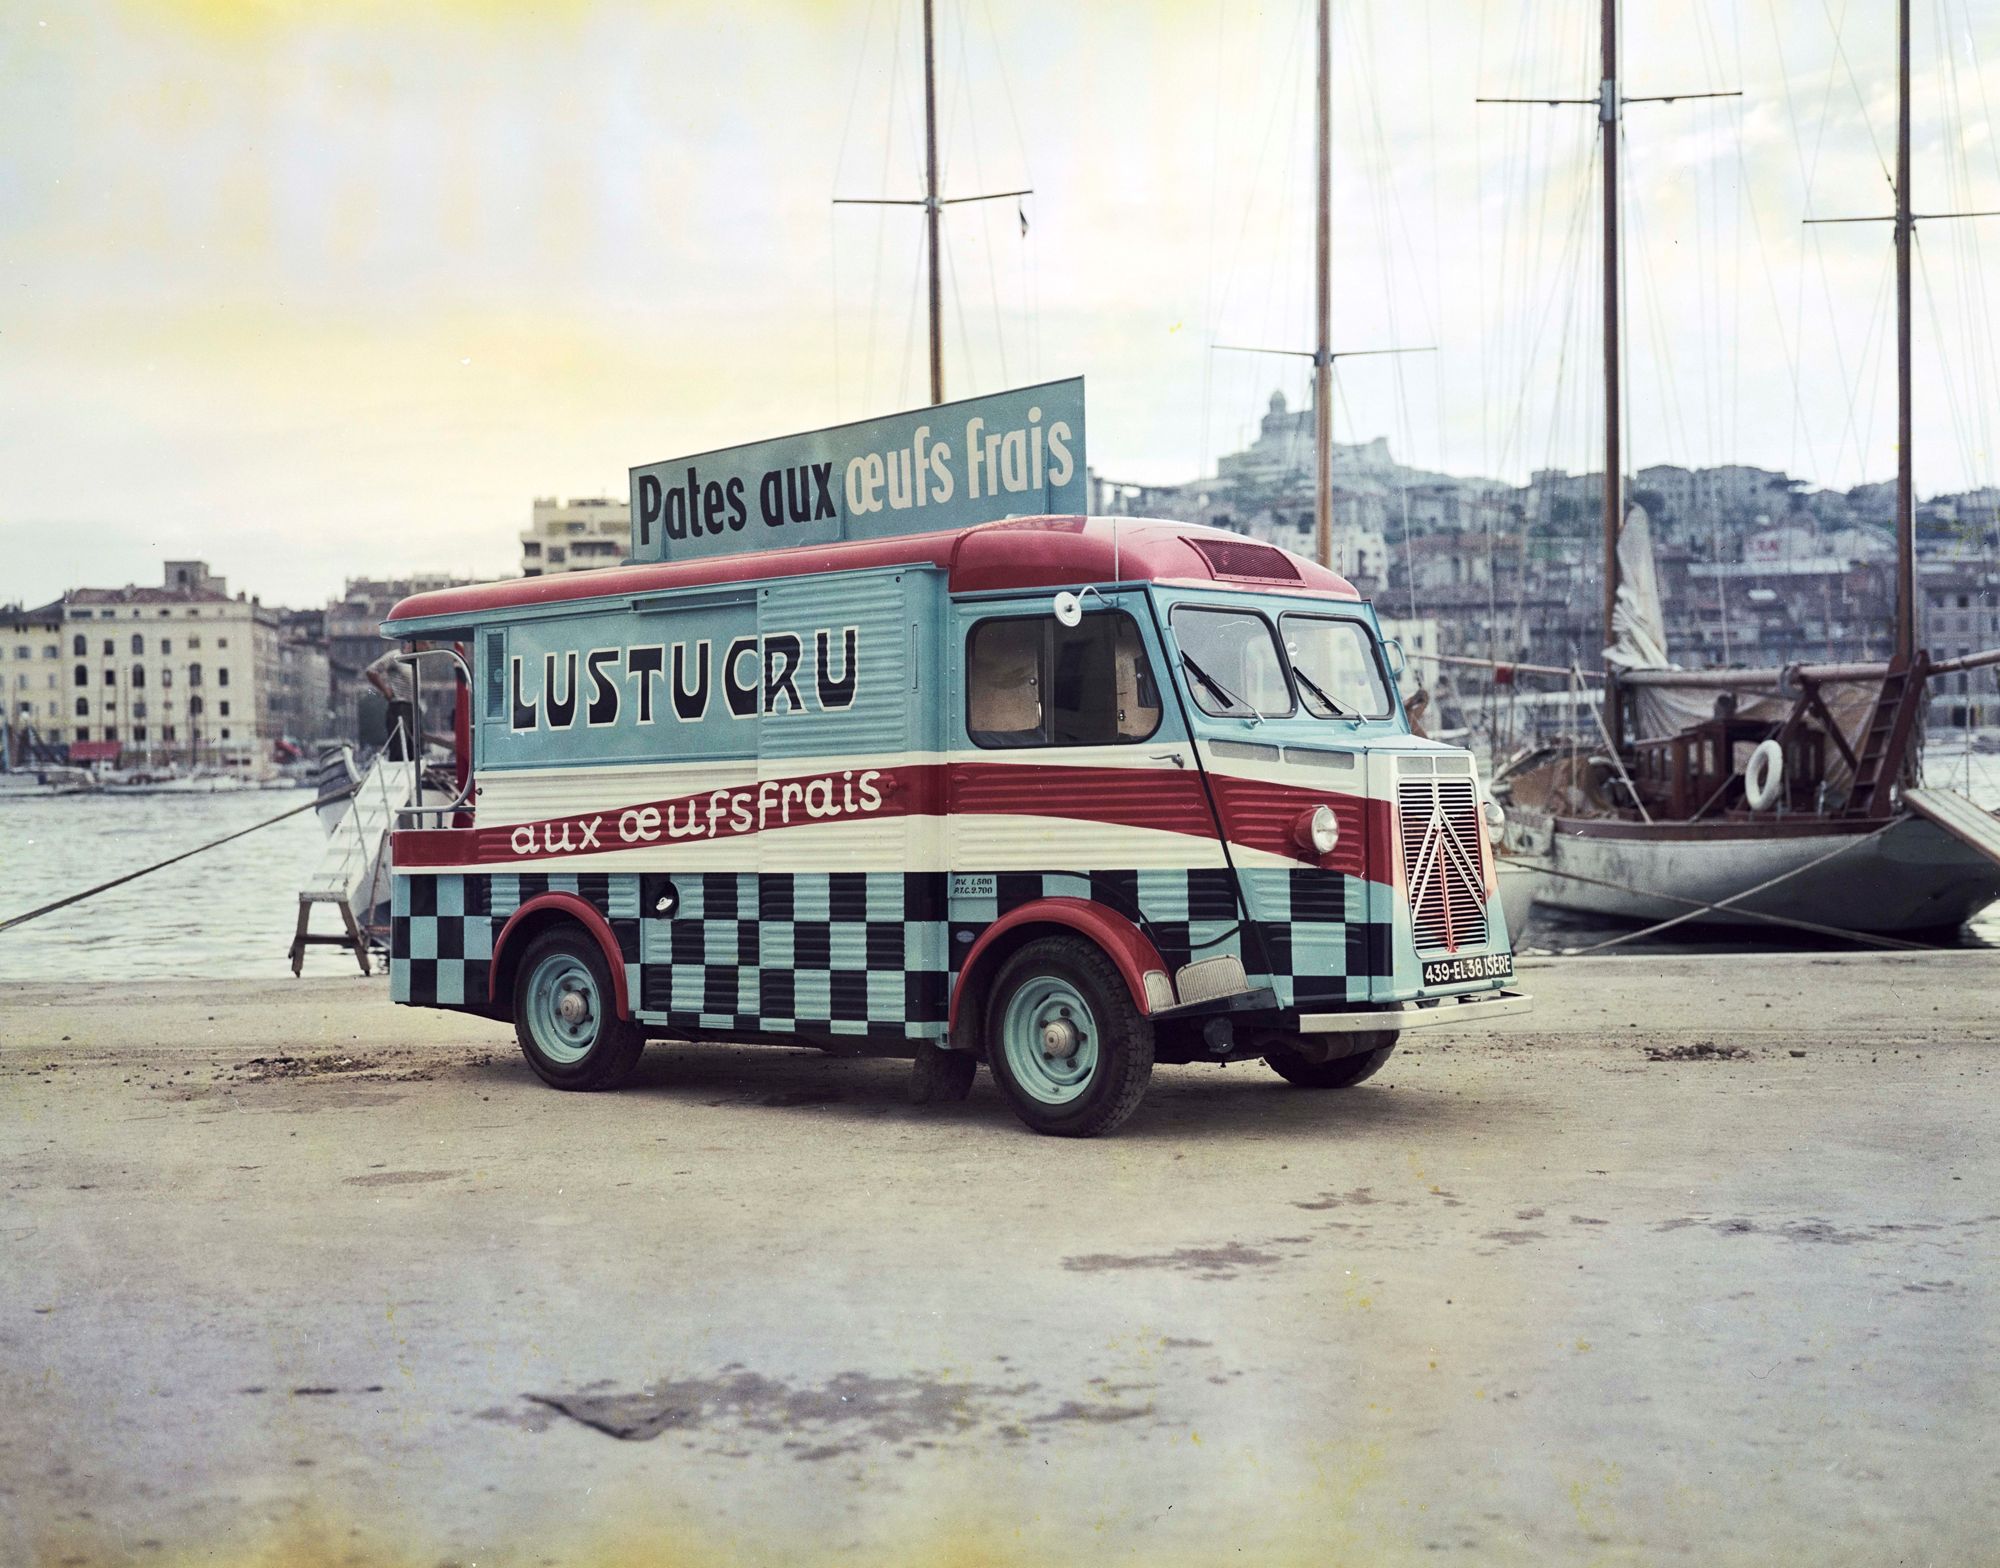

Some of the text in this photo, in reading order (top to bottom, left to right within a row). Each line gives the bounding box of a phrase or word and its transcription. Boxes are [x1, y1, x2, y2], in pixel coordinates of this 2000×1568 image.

[638, 406, 1074, 546] Pates aux œufs frais
[510, 625, 859, 734] LUSTUCRU
[510, 815, 603, 855] aux
